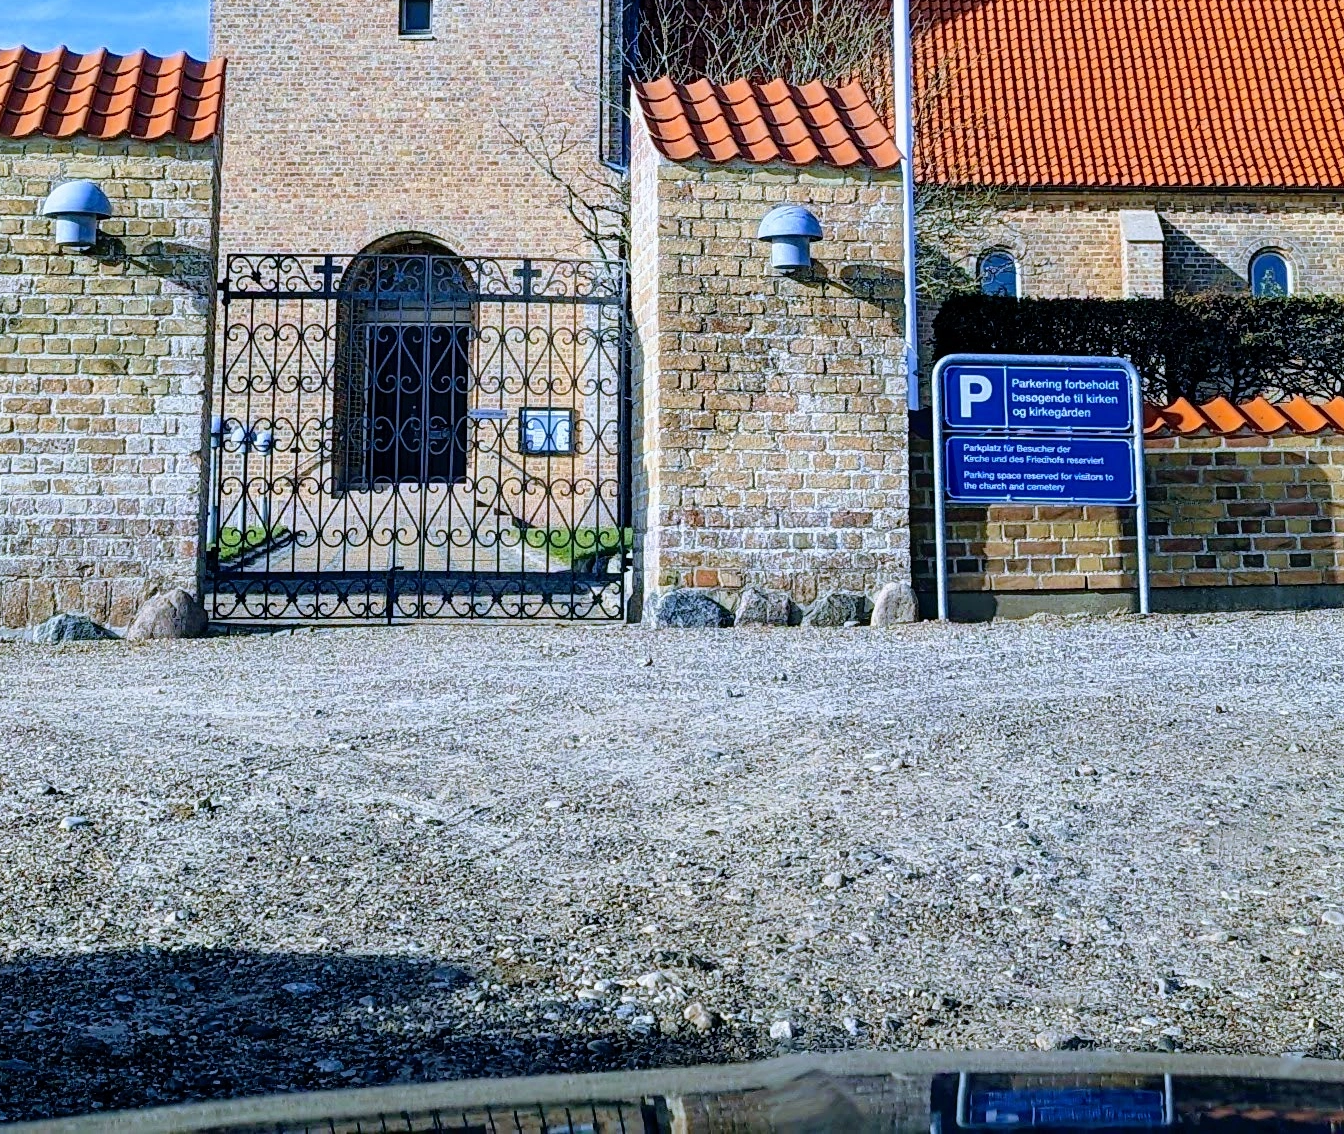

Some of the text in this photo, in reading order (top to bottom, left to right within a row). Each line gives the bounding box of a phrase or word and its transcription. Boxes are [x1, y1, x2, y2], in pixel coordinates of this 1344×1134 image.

[1012, 379, 1119, 390] Parkering forbeholdt
[960, 375, 992, 418] P
[1012, 393, 1118, 404] besøgende til kirken
[1013, 407, 1091, 419] og kirkegården
[963, 444, 1001, 453] Parkplatz
[1017, 445, 1055, 453] Besucher
[1026, 456, 1064, 464] Friedhofs
[964, 471, 994, 480] Parking
[997, 473, 1021, 481] space
[1027, 484, 1065, 493] cemetery
